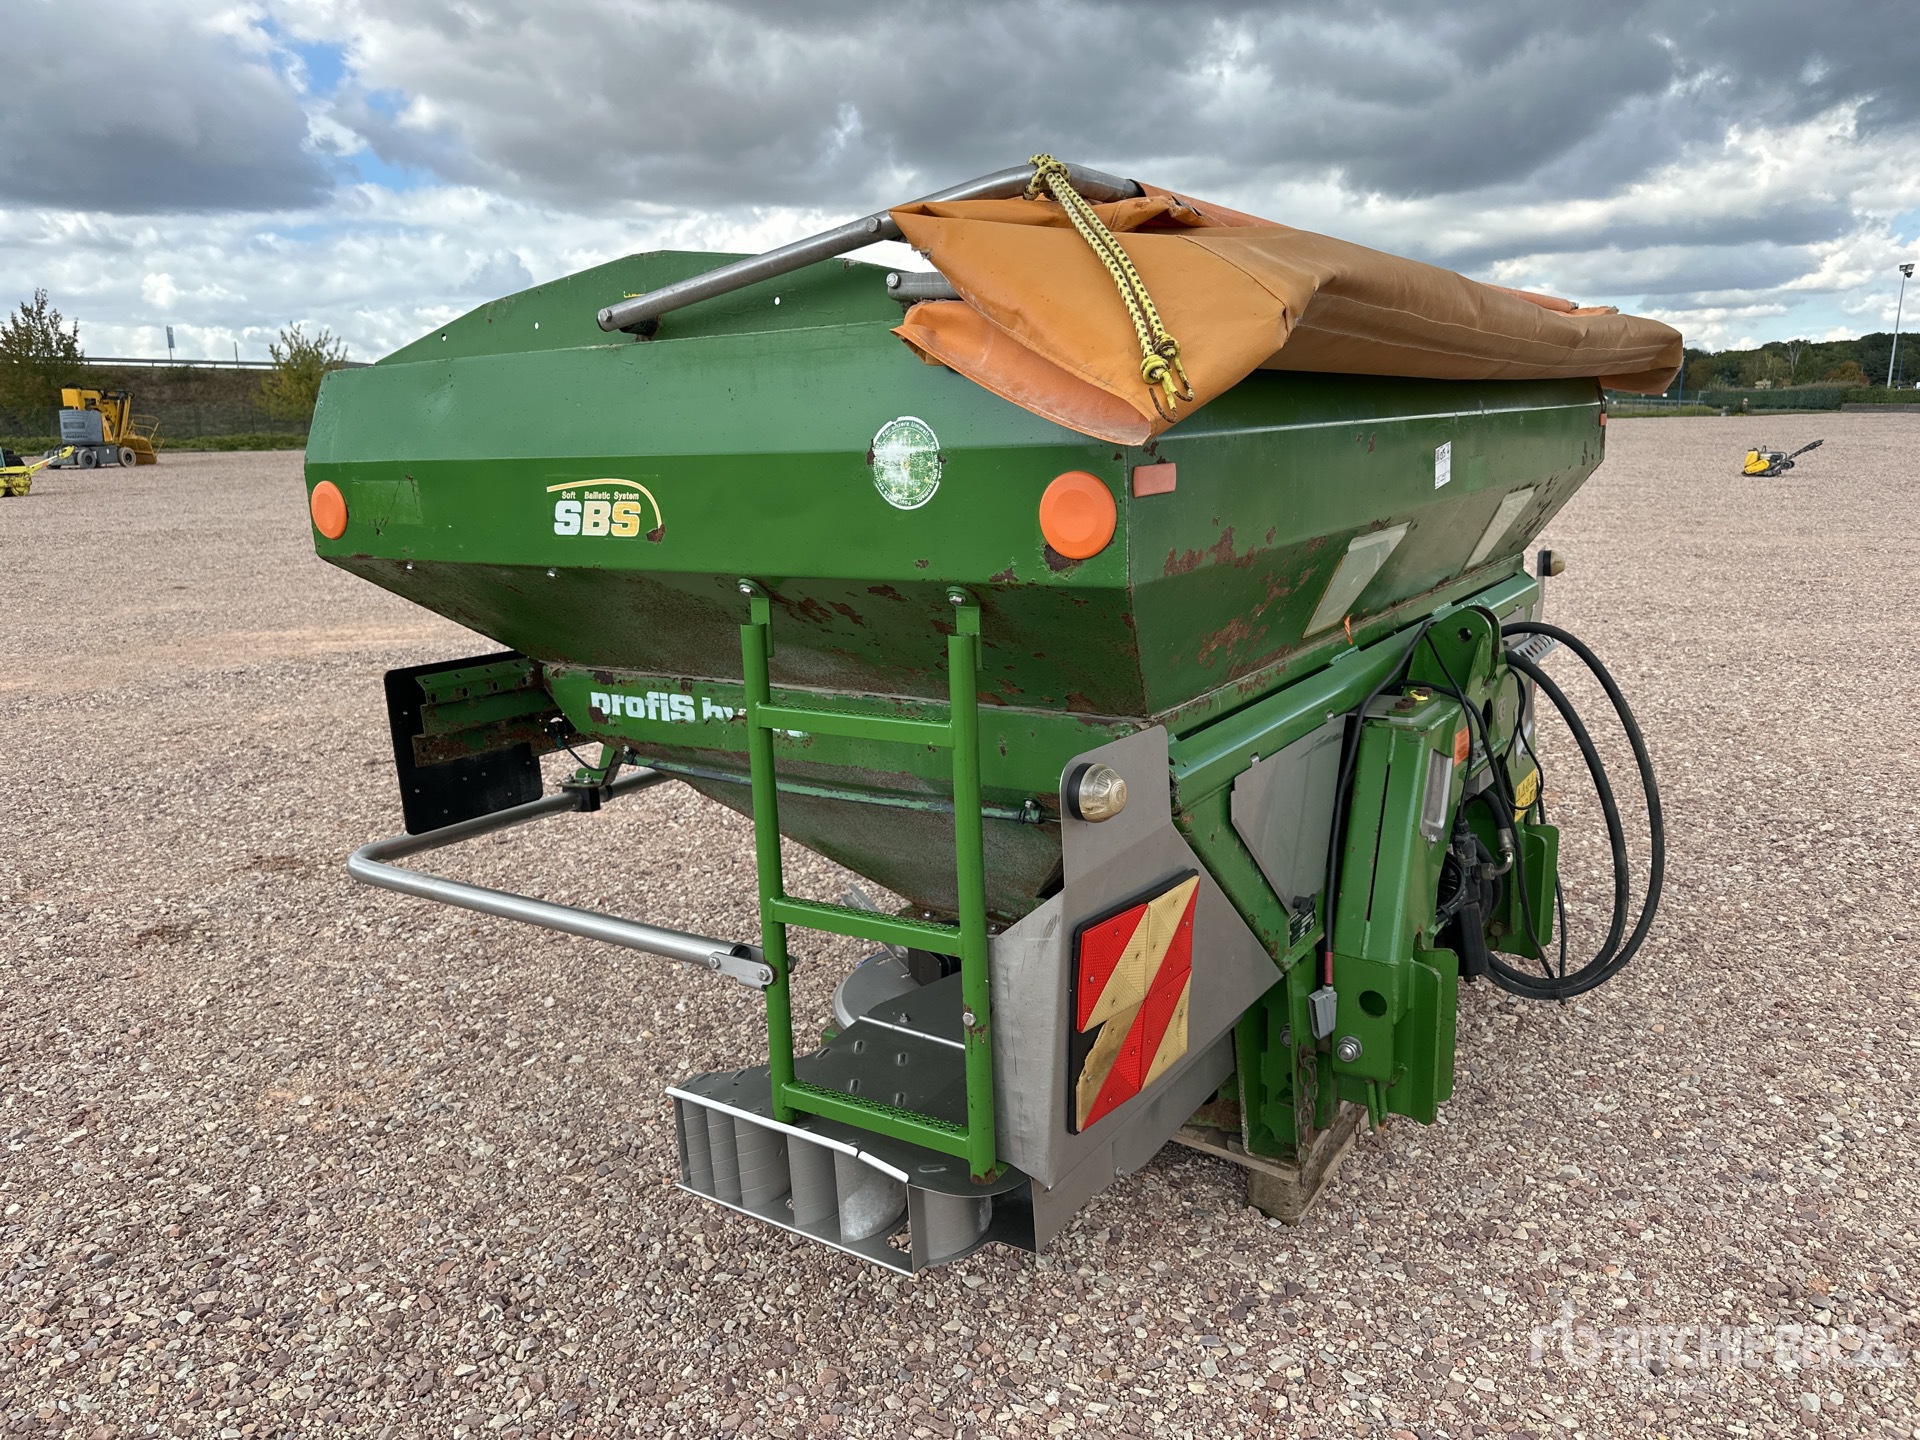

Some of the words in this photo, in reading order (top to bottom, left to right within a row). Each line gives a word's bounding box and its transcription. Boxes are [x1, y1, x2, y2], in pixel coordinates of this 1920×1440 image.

[561, 491, 576, 500] Soft
[584, 491, 611, 500] Ballistic
[613, 491, 640, 501] System
[553, 500, 642, 537] SBS
[590, 691, 696, 723] profiS
